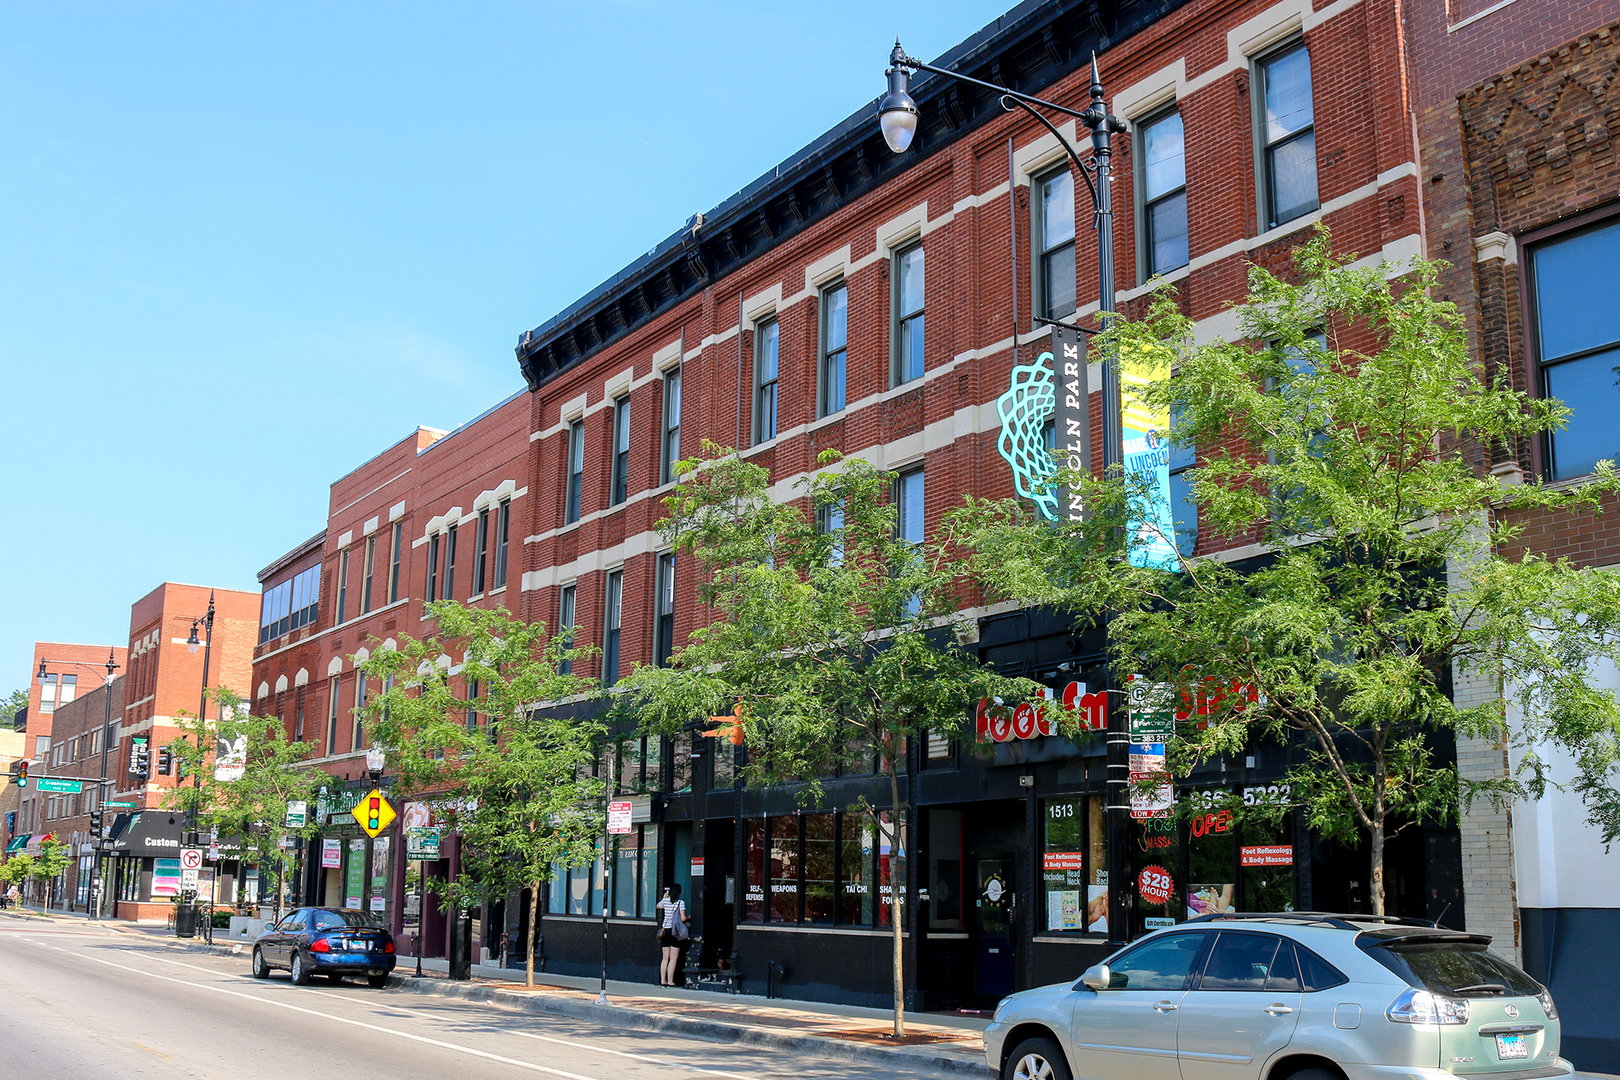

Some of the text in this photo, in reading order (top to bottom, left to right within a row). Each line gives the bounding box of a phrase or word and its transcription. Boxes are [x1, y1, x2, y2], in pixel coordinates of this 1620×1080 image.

[1063, 342, 1080, 410] PARK
[1130, 451, 1168, 472] LINCOLN
[1050, 804, 1073, 818] 1513
[145, 837, 178, 848] Custom
[1257, 847, 1293, 856] Reflexology
[1249, 857, 1264, 865] Body
[1265, 856, 1293, 864] Massage
[1043, 872, 1065, 881] Includes
[1067, 869, 1080, 877] Head
[1142, 870, 1170, 890] $28
[1067, 878, 1080, 886] Neck
[771, 885, 797, 893] WEAPONS
[846, 885, 856, 894] TAI
[856, 885, 868, 894] CHI
[880, 885, 906, 894] SHAIN
[745, 893, 764, 901] DEFENSE
[882, 896, 904, 905] FOS
